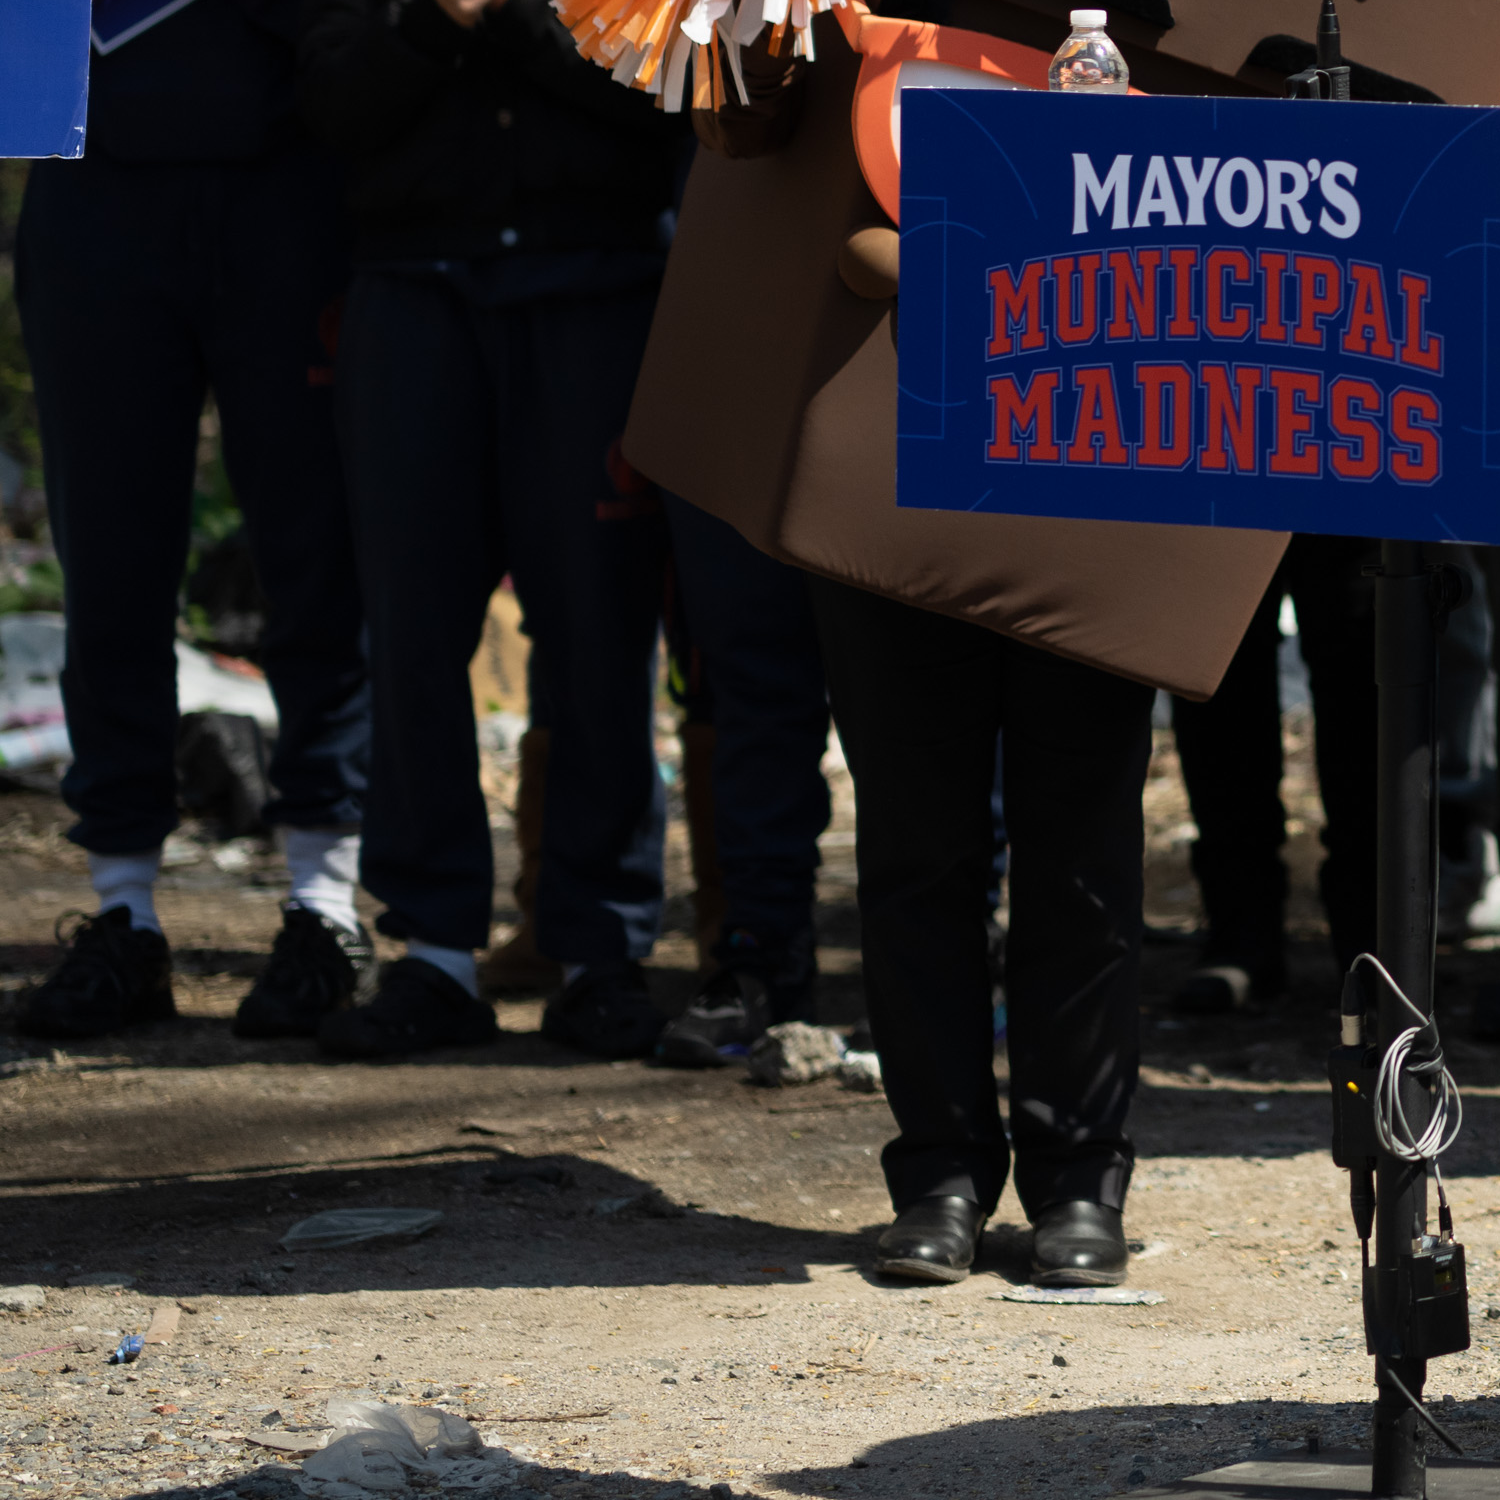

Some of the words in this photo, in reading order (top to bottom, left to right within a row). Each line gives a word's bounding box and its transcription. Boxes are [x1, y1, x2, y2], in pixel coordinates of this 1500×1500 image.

[1072, 152, 1361, 239] MAYOR'S
[985, 244, 1444, 377] MUNICIPAL
[985, 360, 1443, 486] MADNESS
